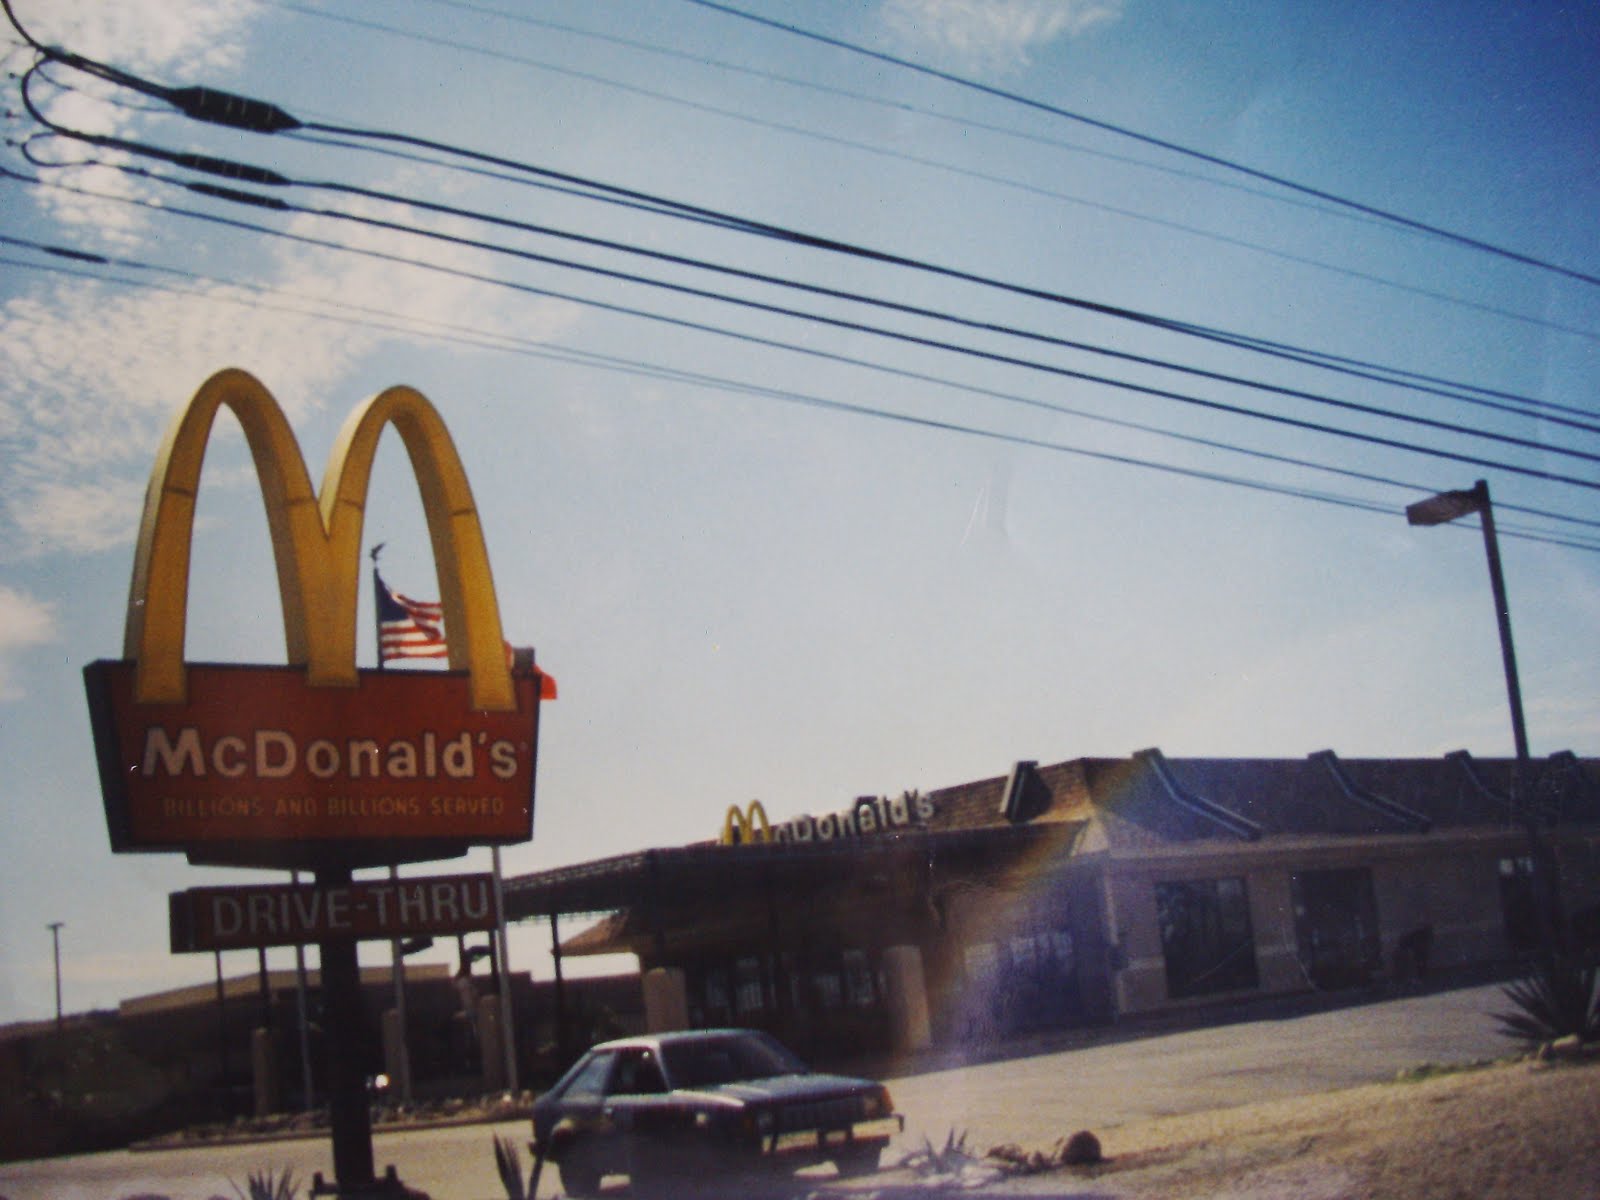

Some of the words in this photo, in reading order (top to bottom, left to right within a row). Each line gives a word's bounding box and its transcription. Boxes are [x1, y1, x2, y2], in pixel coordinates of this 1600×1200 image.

[142, 727, 518, 778] McDonald's
[164, 797, 264, 817] BILLIONS
[274, 797, 318, 816] AND
[327, 797, 420, 816] BILLIONS
[430, 797, 505, 816] SERVED
[211, 880, 490, 937] DRIVE-THRU
